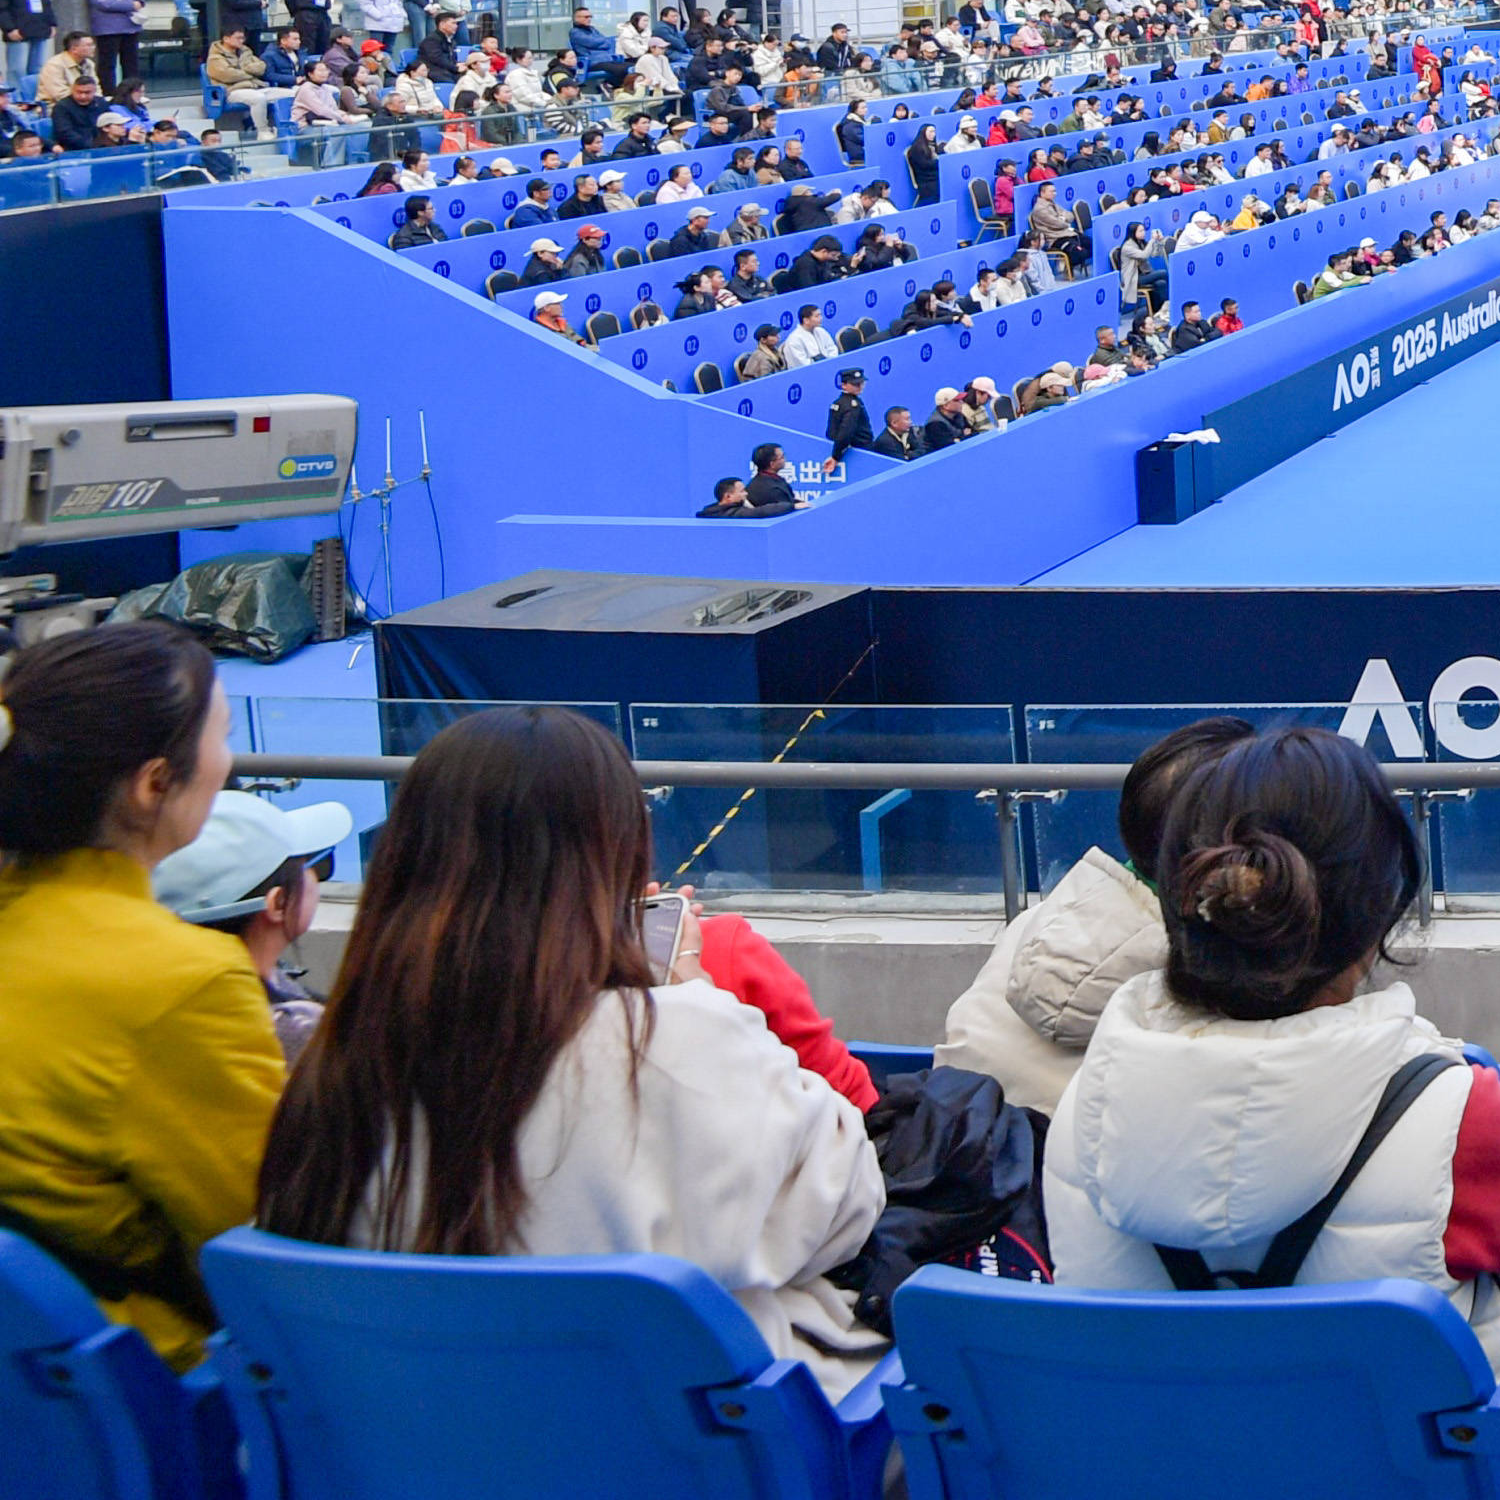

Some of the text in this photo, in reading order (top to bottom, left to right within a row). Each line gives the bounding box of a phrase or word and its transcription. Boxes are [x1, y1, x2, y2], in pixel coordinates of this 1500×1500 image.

[1392, 318, 1437, 376] 2025
[1333, 352, 1370, 412] AO
[109, 479, 164, 508] 101
